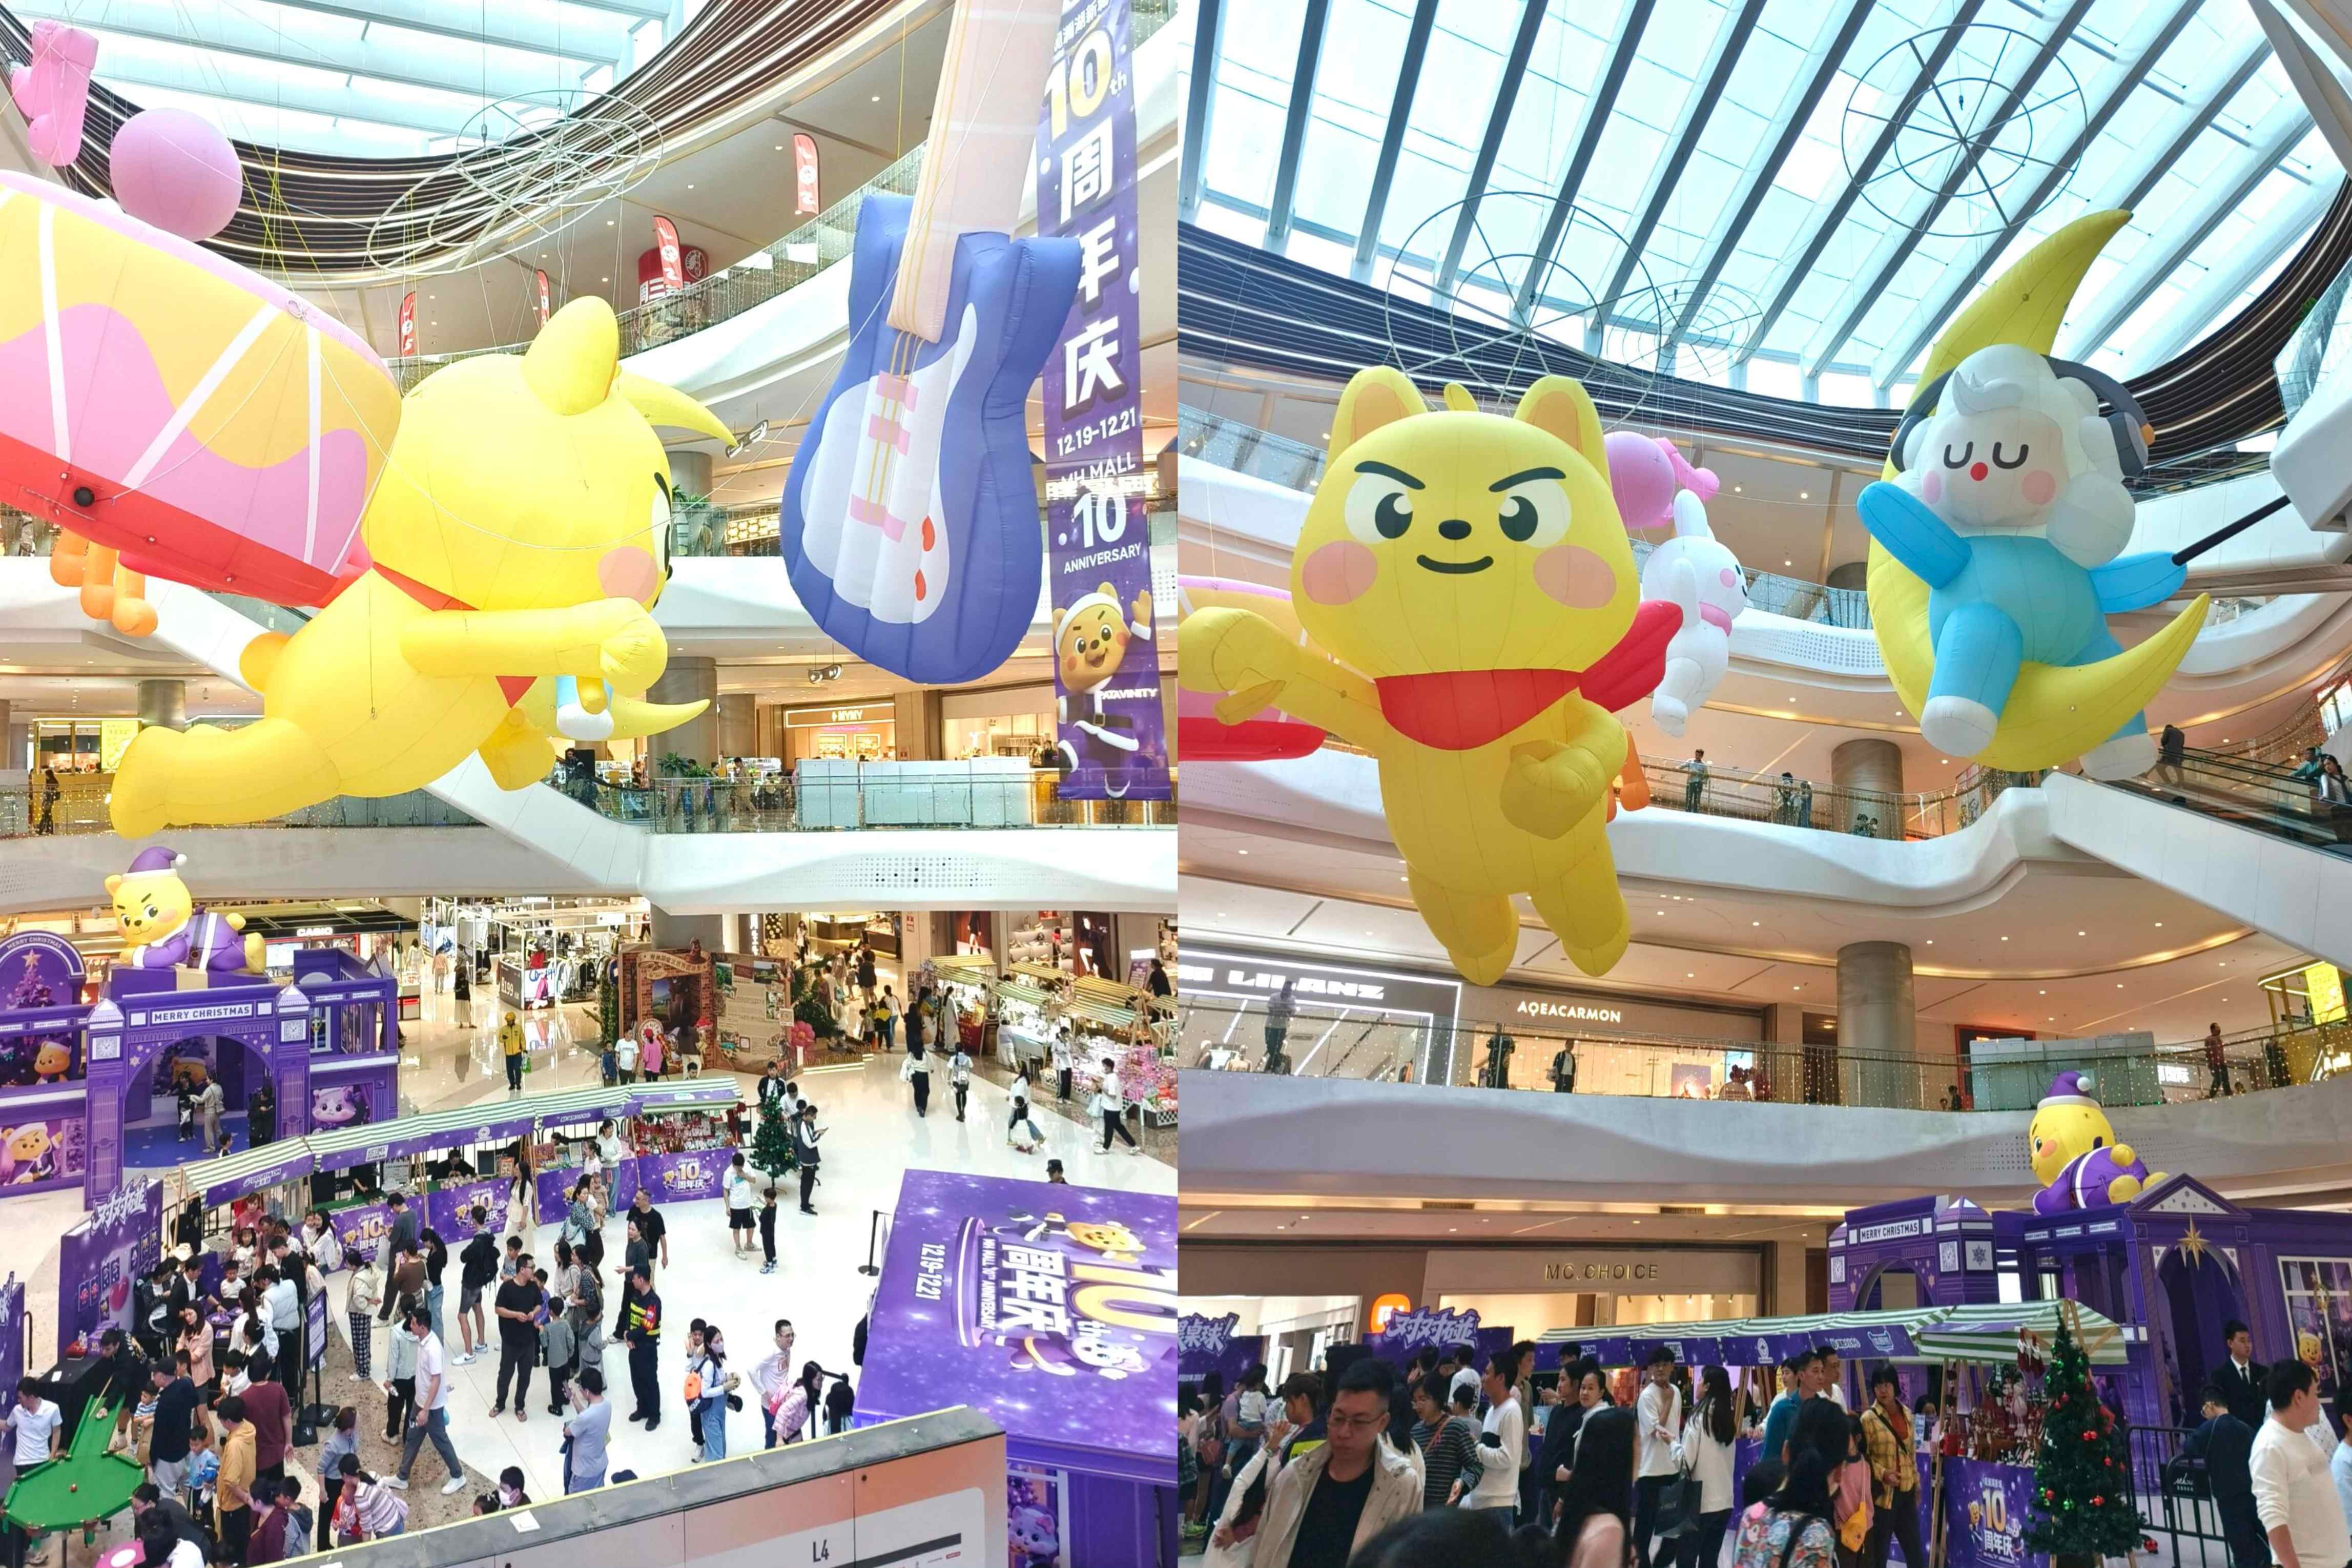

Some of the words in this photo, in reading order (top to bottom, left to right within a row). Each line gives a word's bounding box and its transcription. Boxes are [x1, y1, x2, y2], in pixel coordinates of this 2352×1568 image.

[1059, 117, 1123, 410] 周年庆
[1090, 451, 1136, 480] MALL
[1073, 492, 1127, 548] 10
[1064, 542, 1141, 574] ANNIVERSARY
[7, 937, 28, 950] MERRY
[29, 937, 63, 948] CHRISTMAS
[154, 1011, 189, 1022] MERRY
[193, 1006, 250, 1018] CHRISTMAS
[1517, 1001, 1621, 1023] AQEACARMON
[678, 1162, 700, 1180] 10
[360, 1217, 384, 1239] 10
[1862, 1228, 1881, 1240] MERRY
[1883, 1223, 1918, 1237] CHRISTMAS
[1001, 1244, 1071, 1336] 周年庆
[981, 1280, 996, 1330] ANNIVERSARY
[1387, 1311, 1476, 1347] 对对碰
[1983, 1489, 2006, 1532] 10
[813, 1539, 829, 1562] L4
[1984, 1529, 2015, 1558] 周年庆
